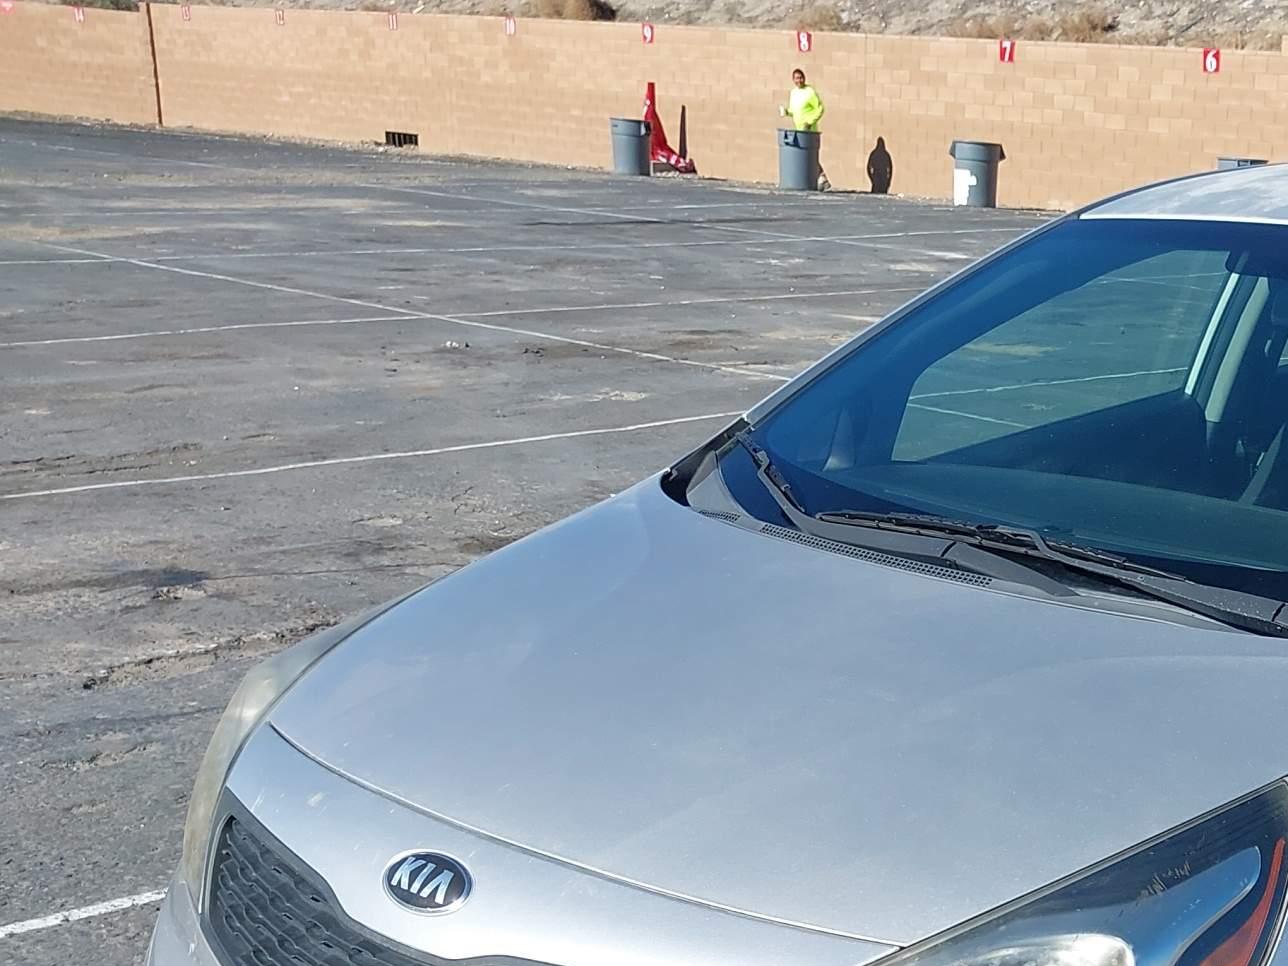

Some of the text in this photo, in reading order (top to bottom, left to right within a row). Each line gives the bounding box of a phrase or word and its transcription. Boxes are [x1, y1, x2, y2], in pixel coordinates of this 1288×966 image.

[643, 24, 653, 43] 9
[799, 31, 809, 51] 8
[1001, 41, 1011, 62] 7
[1205, 49, 1217, 72] 6
[390, 856, 454, 905] KIA
